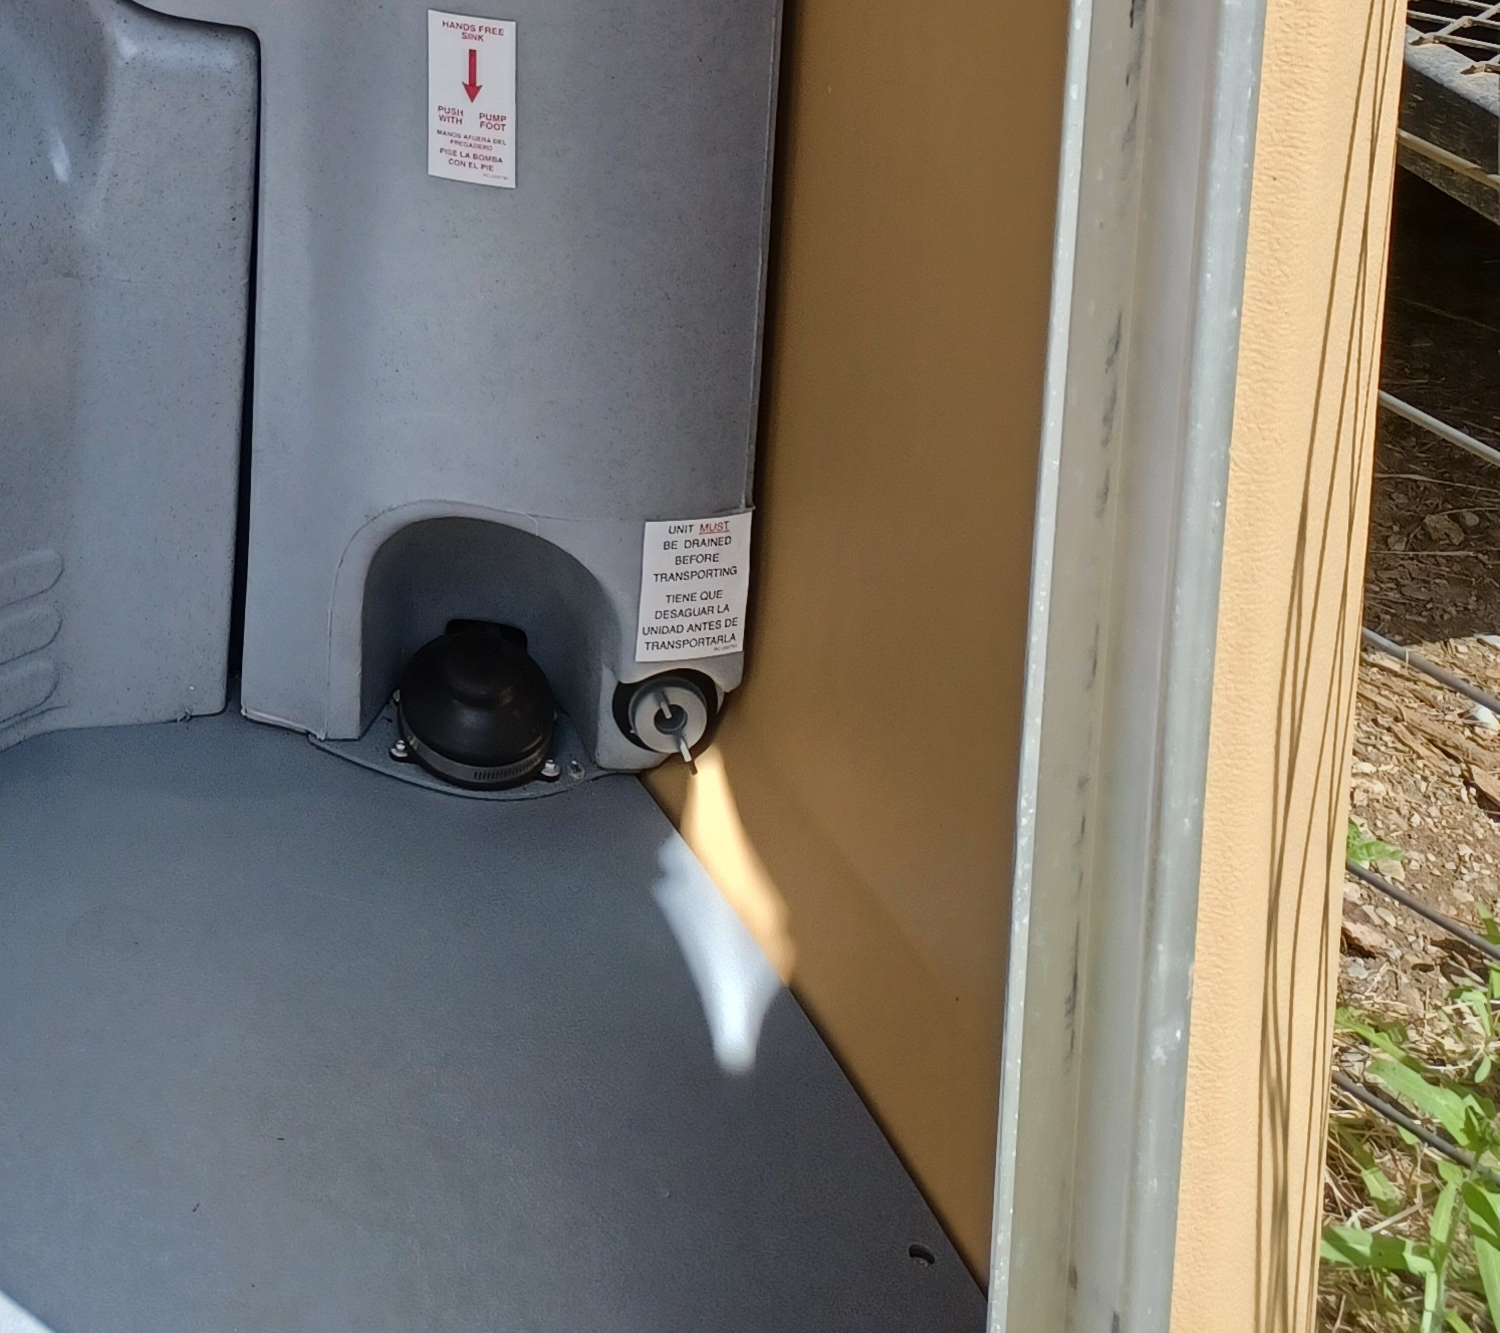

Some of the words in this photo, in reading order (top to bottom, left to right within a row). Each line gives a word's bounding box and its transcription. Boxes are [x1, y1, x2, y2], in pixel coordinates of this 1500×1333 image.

[442, 20, 476, 33] HANDS
[478, 25, 505, 36] FREE
[461, 32, 484, 42] SINK
[437, 105, 464, 117] PUSH
[478, 112, 507, 122] PUMP
[438, 114, 463, 125] WITH
[479, 121, 506, 132] FOOT
[448, 158, 467, 168] CON
[468, 161, 479, 170] EL
[480, 162, 494, 172] PIE
[459, 151, 471, 159] LA
[472, 152, 503, 164] BOMBA
[668, 524, 695, 535] UNIT
[699, 521, 730, 535] MUST
[663, 540, 679, 551] BE
[684, 536, 732, 549] DRAINED
[674, 553, 720, 566] BEFORE
[653, 566, 738, 583] TRANSPORTING
[666, 593, 698, 604] TIENE
[700, 590, 724, 601] QUE
[654, 605, 715, 620] DESAGUAR
[717, 604, 730, 615] LA
[642, 623, 685, 636] UNIDAD
[687, 620, 722, 633] ANTES
[724, 617, 739, 628] DE
[645, 633, 737, 651] TRANSPORTARLA
